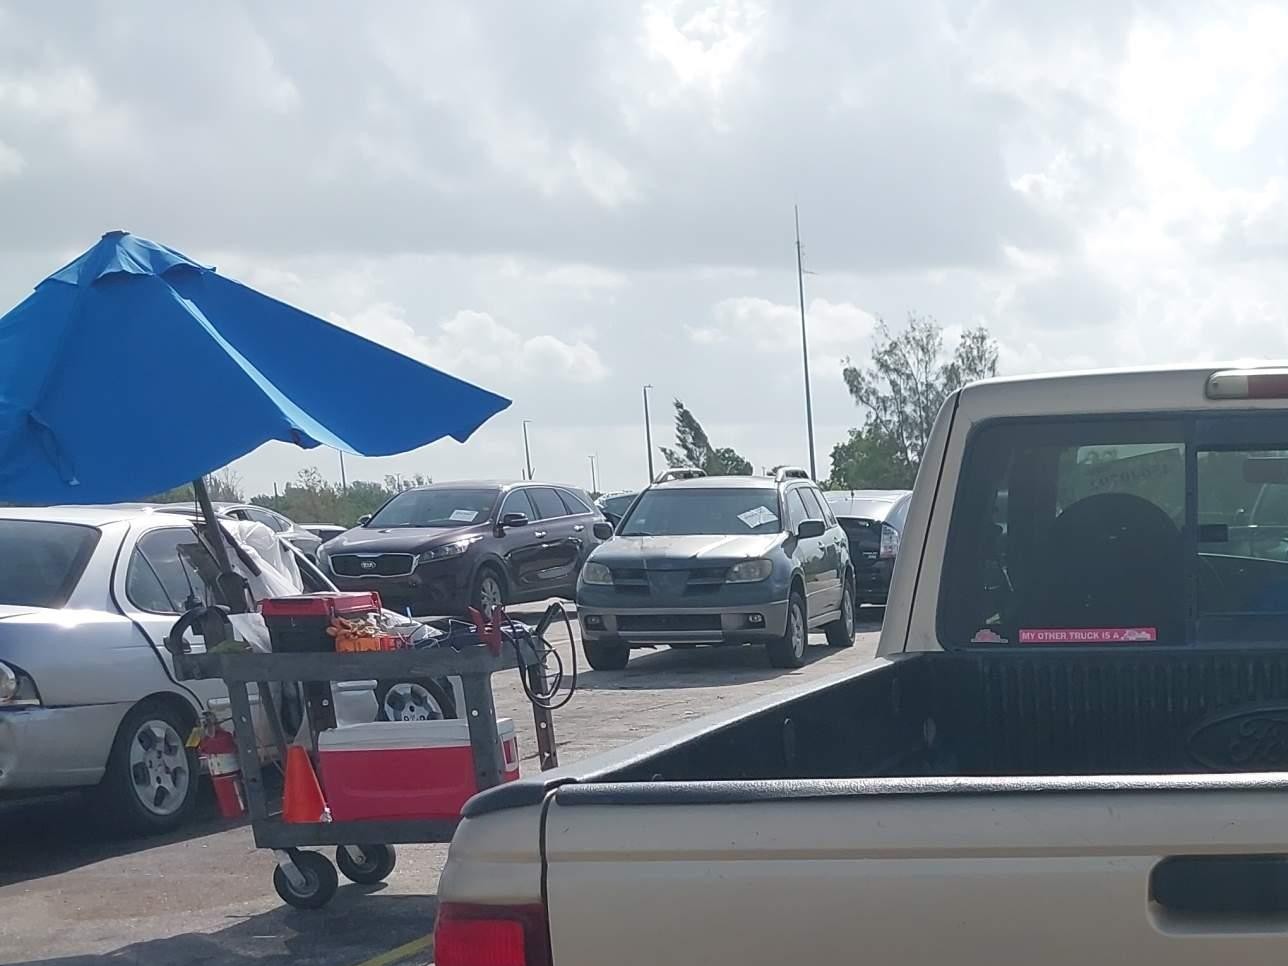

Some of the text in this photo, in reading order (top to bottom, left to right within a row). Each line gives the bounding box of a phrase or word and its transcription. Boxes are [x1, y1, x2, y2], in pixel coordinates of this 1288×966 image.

[1022, 632, 1034, 640] MY
[1037, 631, 1067, 640] OTHER
[1069, 631, 1099, 640] TRUCK
[1102, 631, 1111, 640] IS
